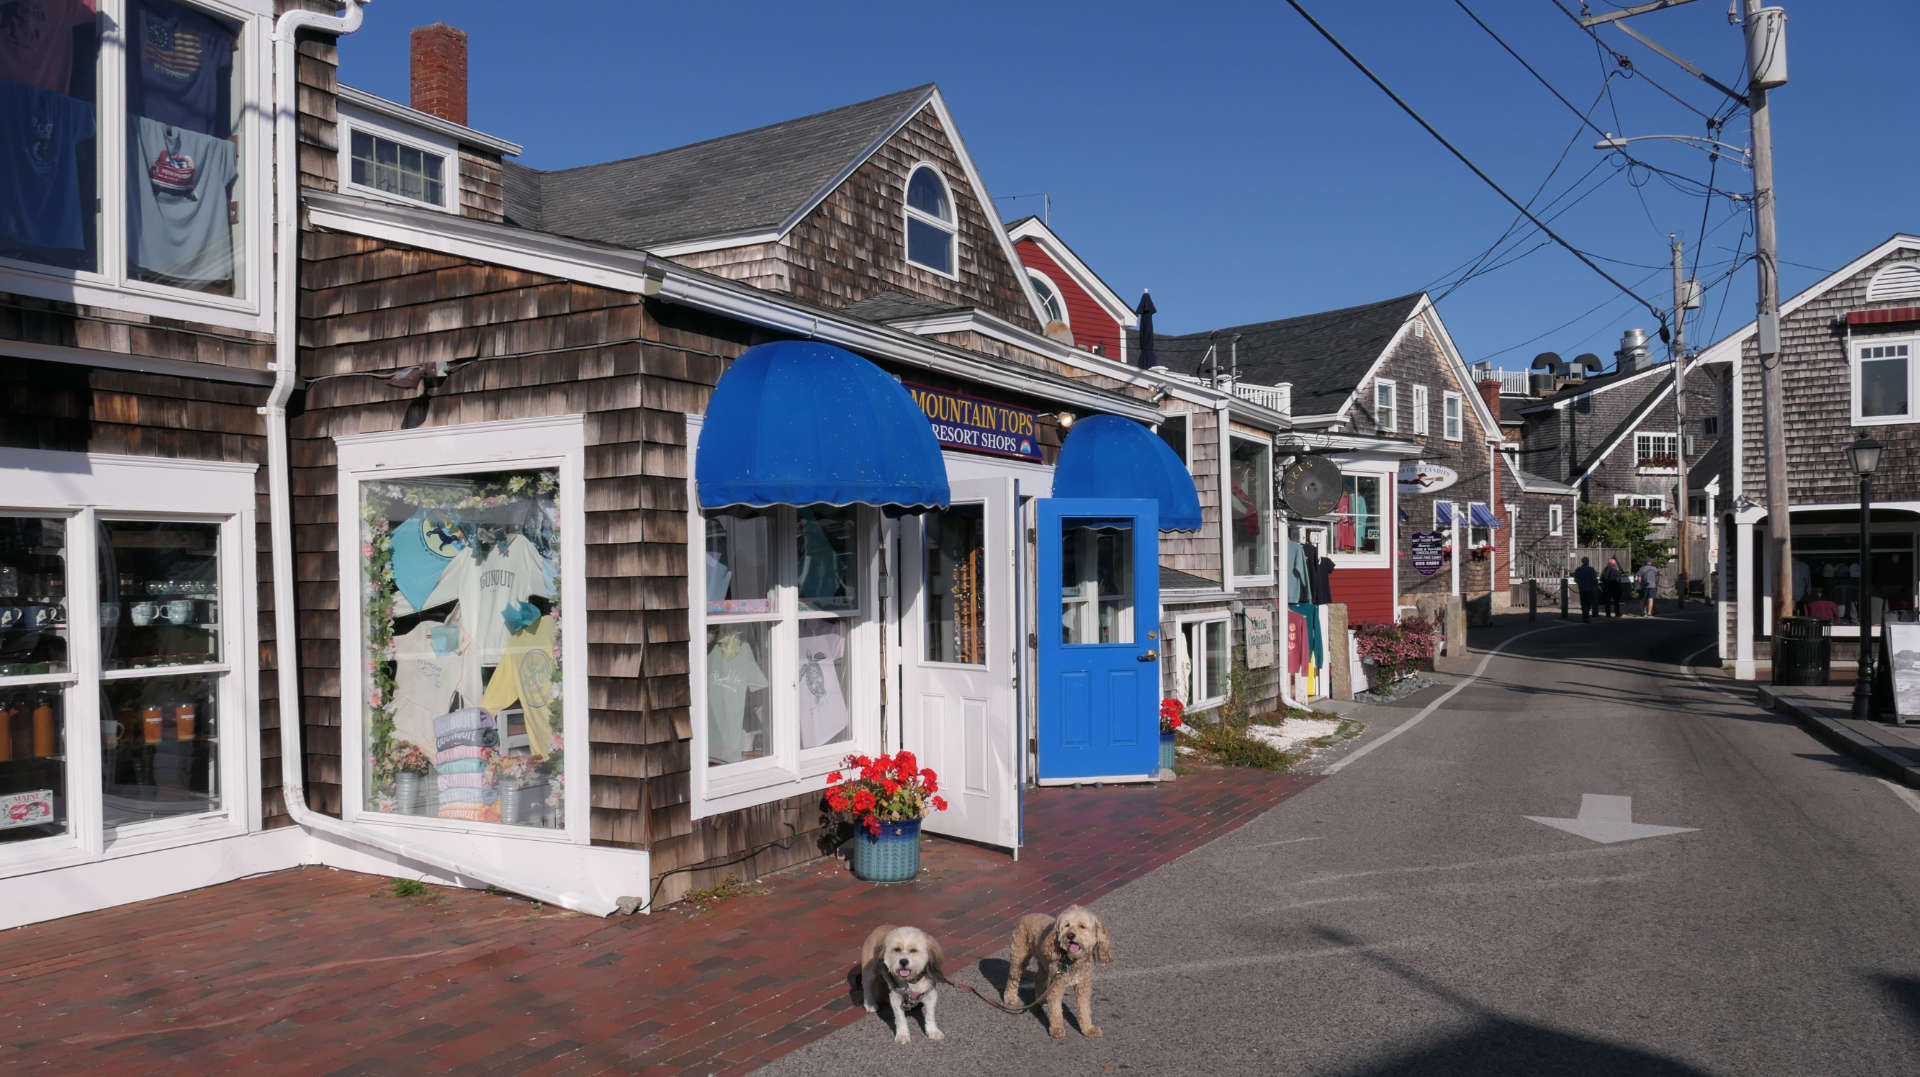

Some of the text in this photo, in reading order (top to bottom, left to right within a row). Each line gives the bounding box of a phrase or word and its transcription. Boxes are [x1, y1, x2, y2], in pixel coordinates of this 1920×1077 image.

[911, 389, 1033, 436] MOUNTAIN TOPS
[931, 423, 1017, 452] RESORT SHOPS
